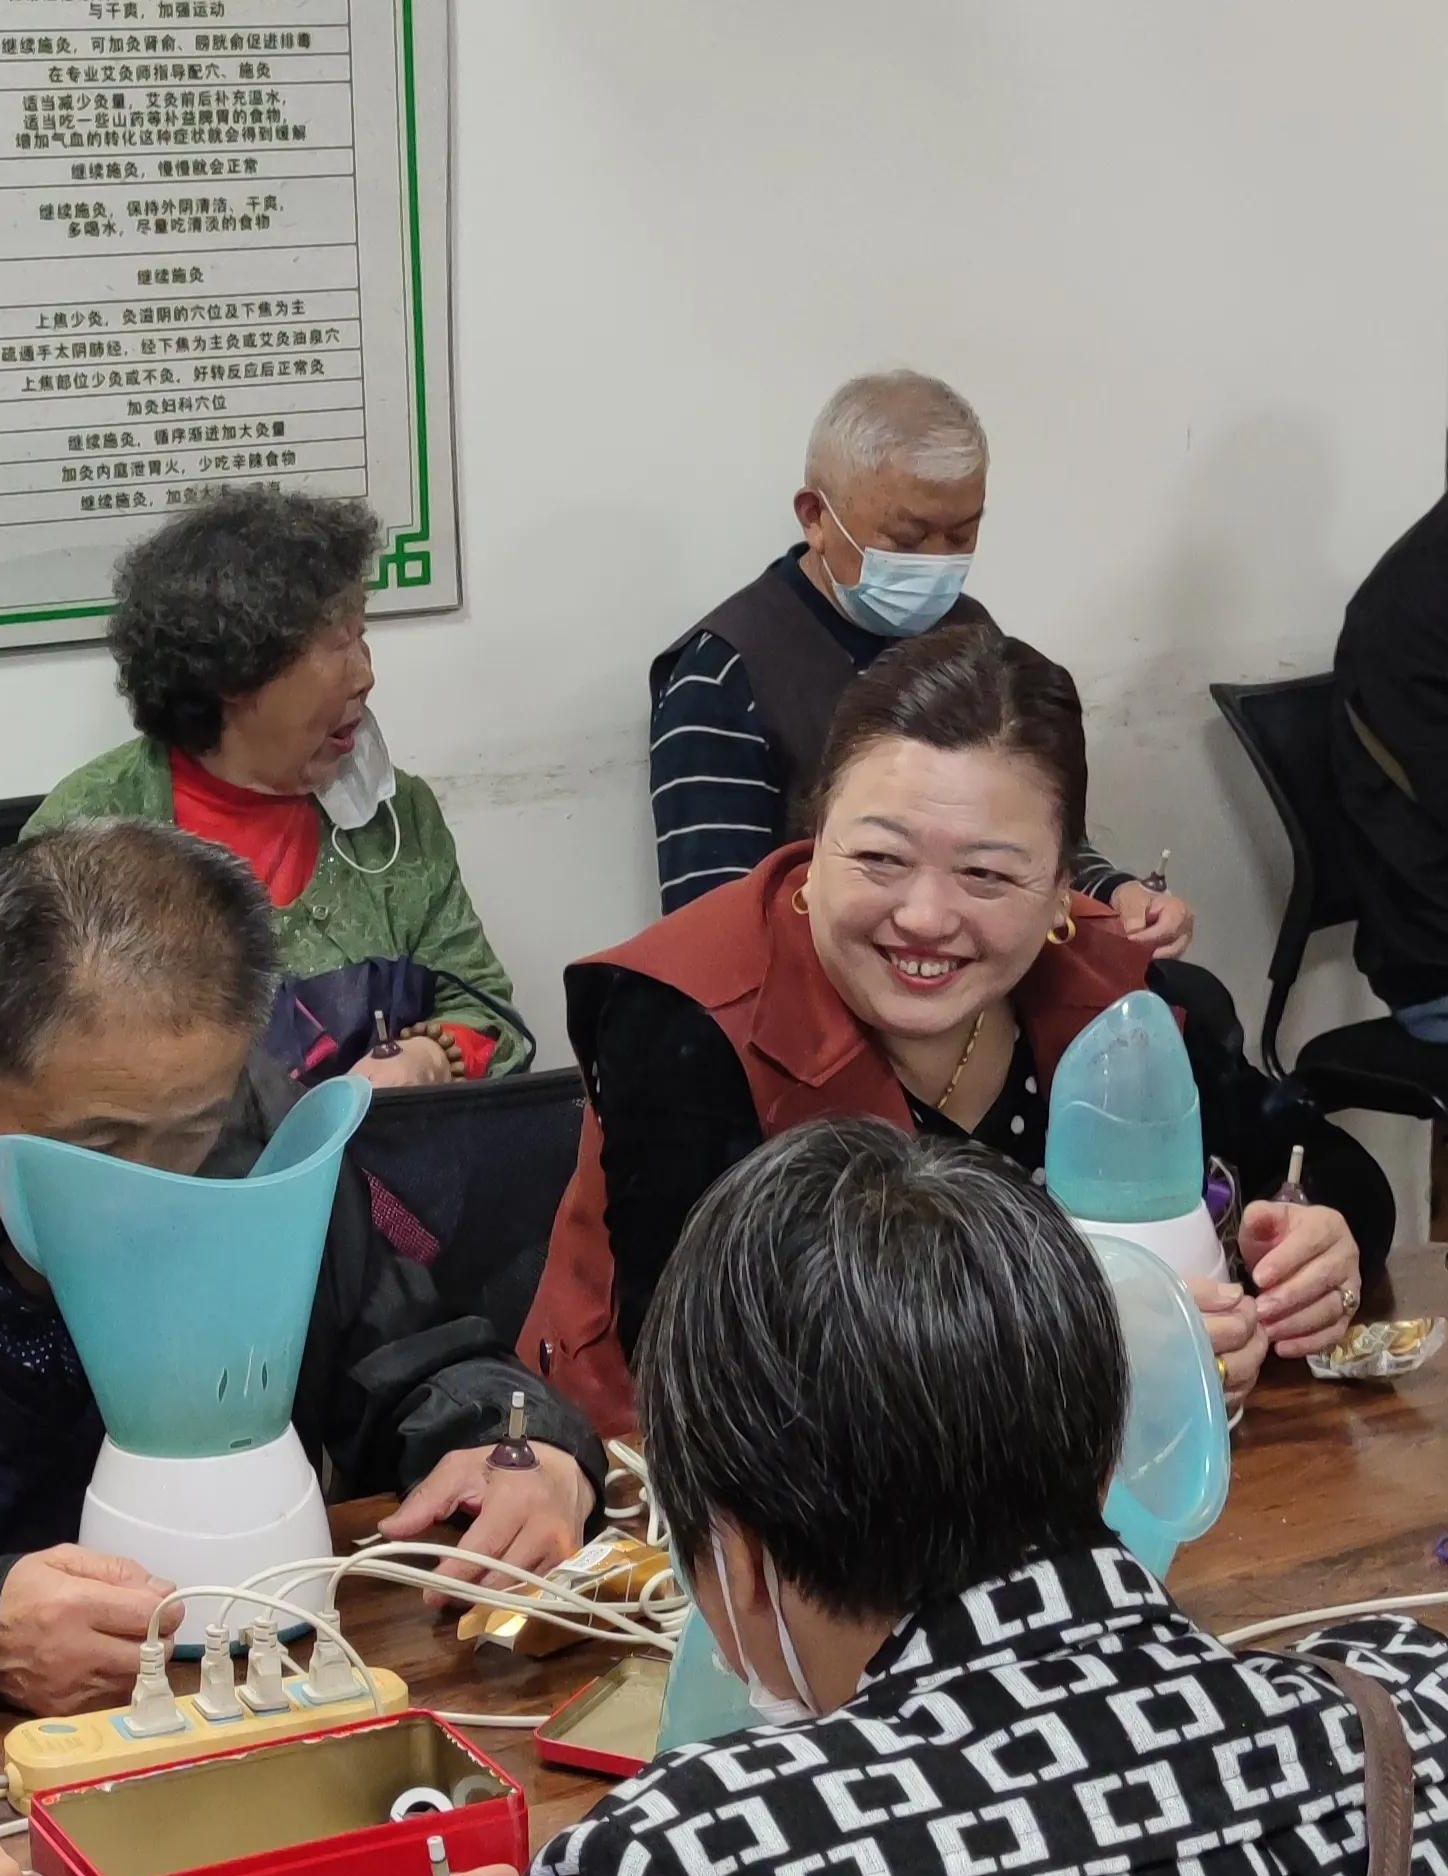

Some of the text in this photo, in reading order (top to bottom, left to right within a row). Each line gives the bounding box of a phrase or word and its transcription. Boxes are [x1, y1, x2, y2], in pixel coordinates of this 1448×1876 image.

[137, 267, 204, 286] 继续施灸
[127, 394, 228, 417] 加灸妇科穴位
